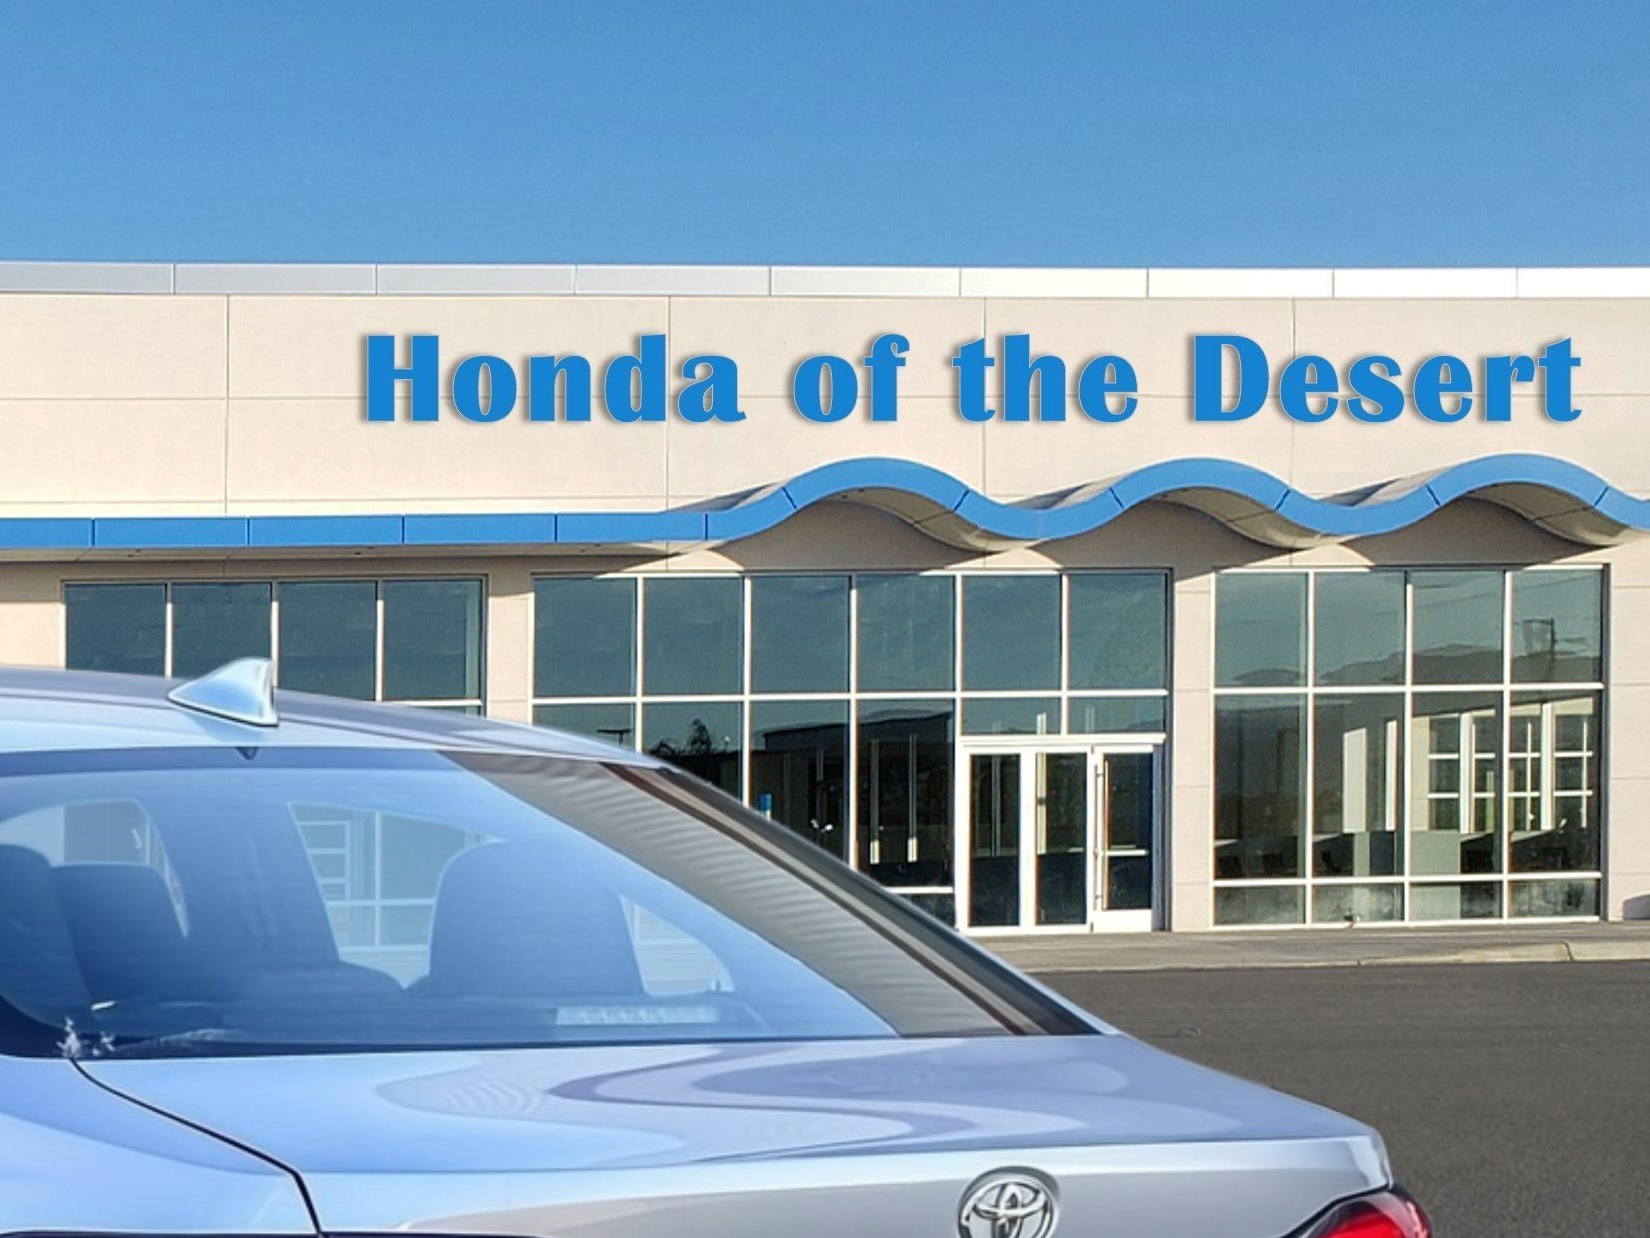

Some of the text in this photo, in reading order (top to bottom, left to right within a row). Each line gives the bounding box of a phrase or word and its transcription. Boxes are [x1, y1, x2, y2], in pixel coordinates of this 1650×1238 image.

[365, 332, 1583, 424] Honda of the Desert
